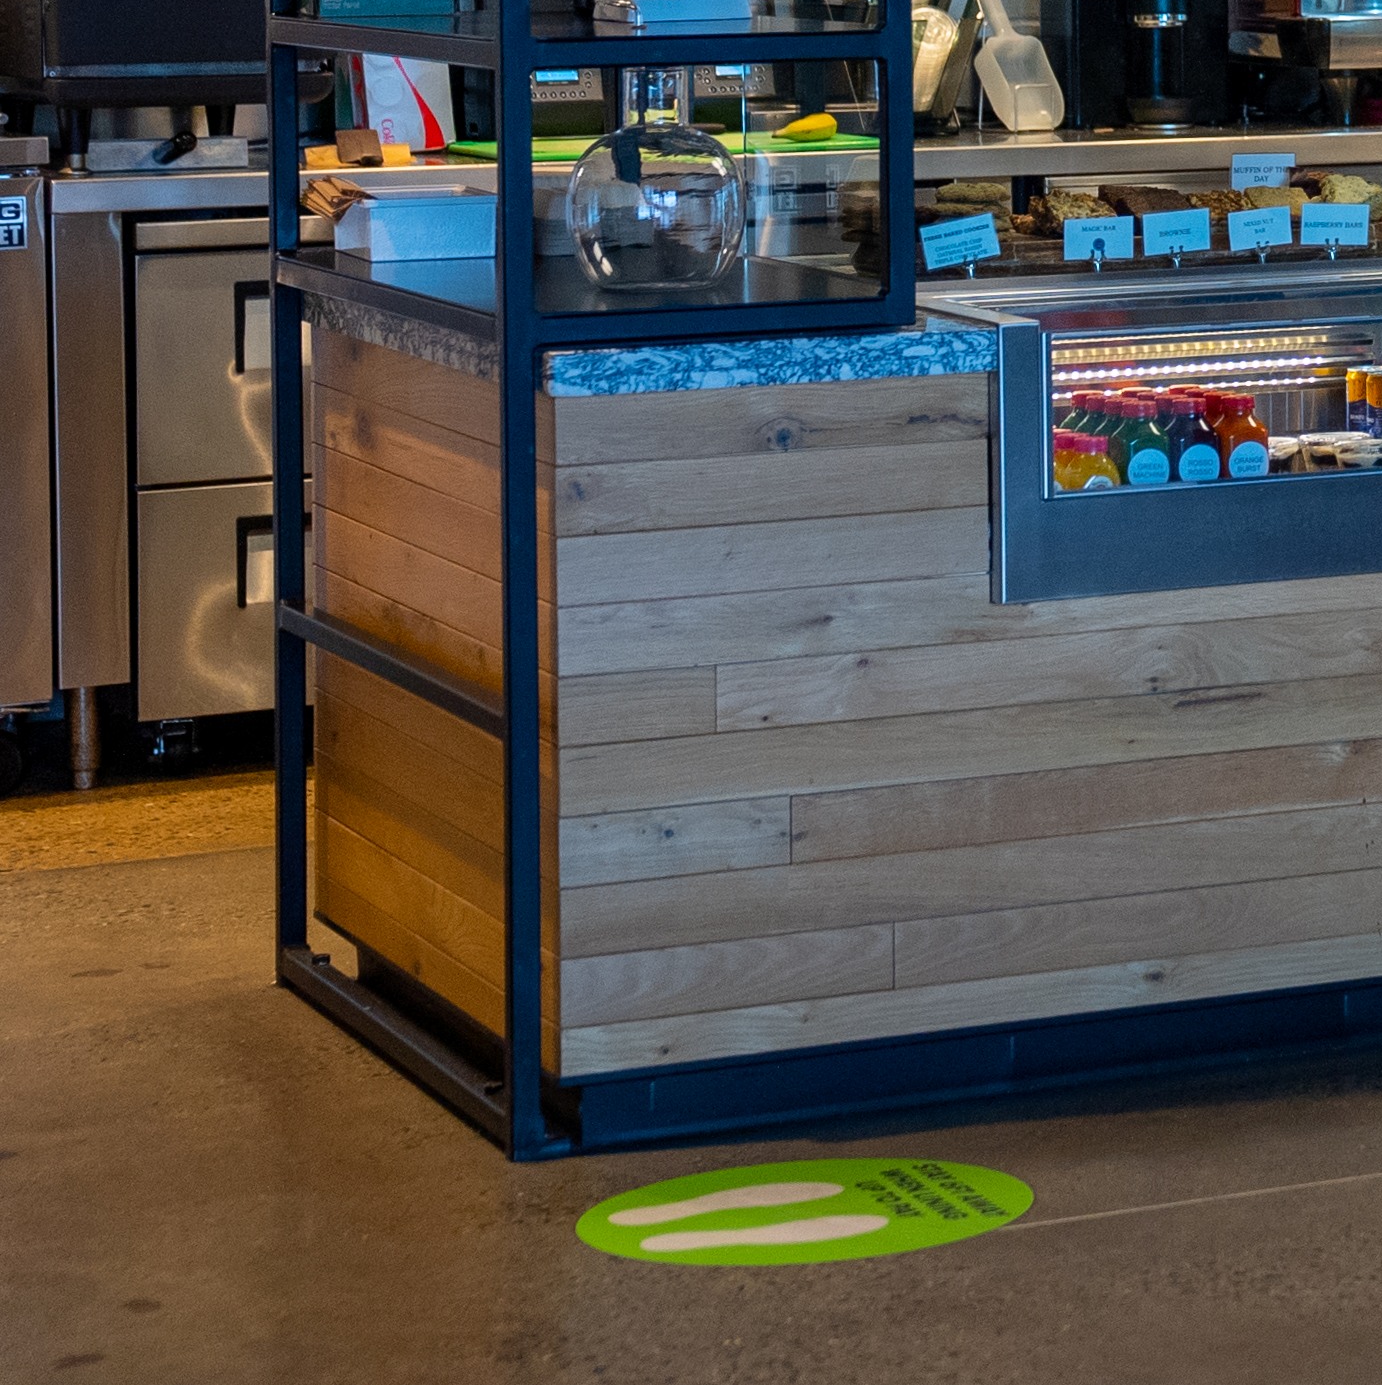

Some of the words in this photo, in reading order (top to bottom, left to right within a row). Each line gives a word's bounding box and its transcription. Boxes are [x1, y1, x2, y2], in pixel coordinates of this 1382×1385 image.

[1233, 165, 1261, 174] MUFFIN
[1263, 166, 1275, 174] OF
[1254, 174, 1268, 183] DAY
[1081, 225, 1100, 233] MAGIC
[1304, 222, 1343, 230] RASPBERRY
[1344, 221, 1363, 229] BARS
[1234, 455, 1264, 465] ORANGE
[1237, 465, 1261, 474] BURST
